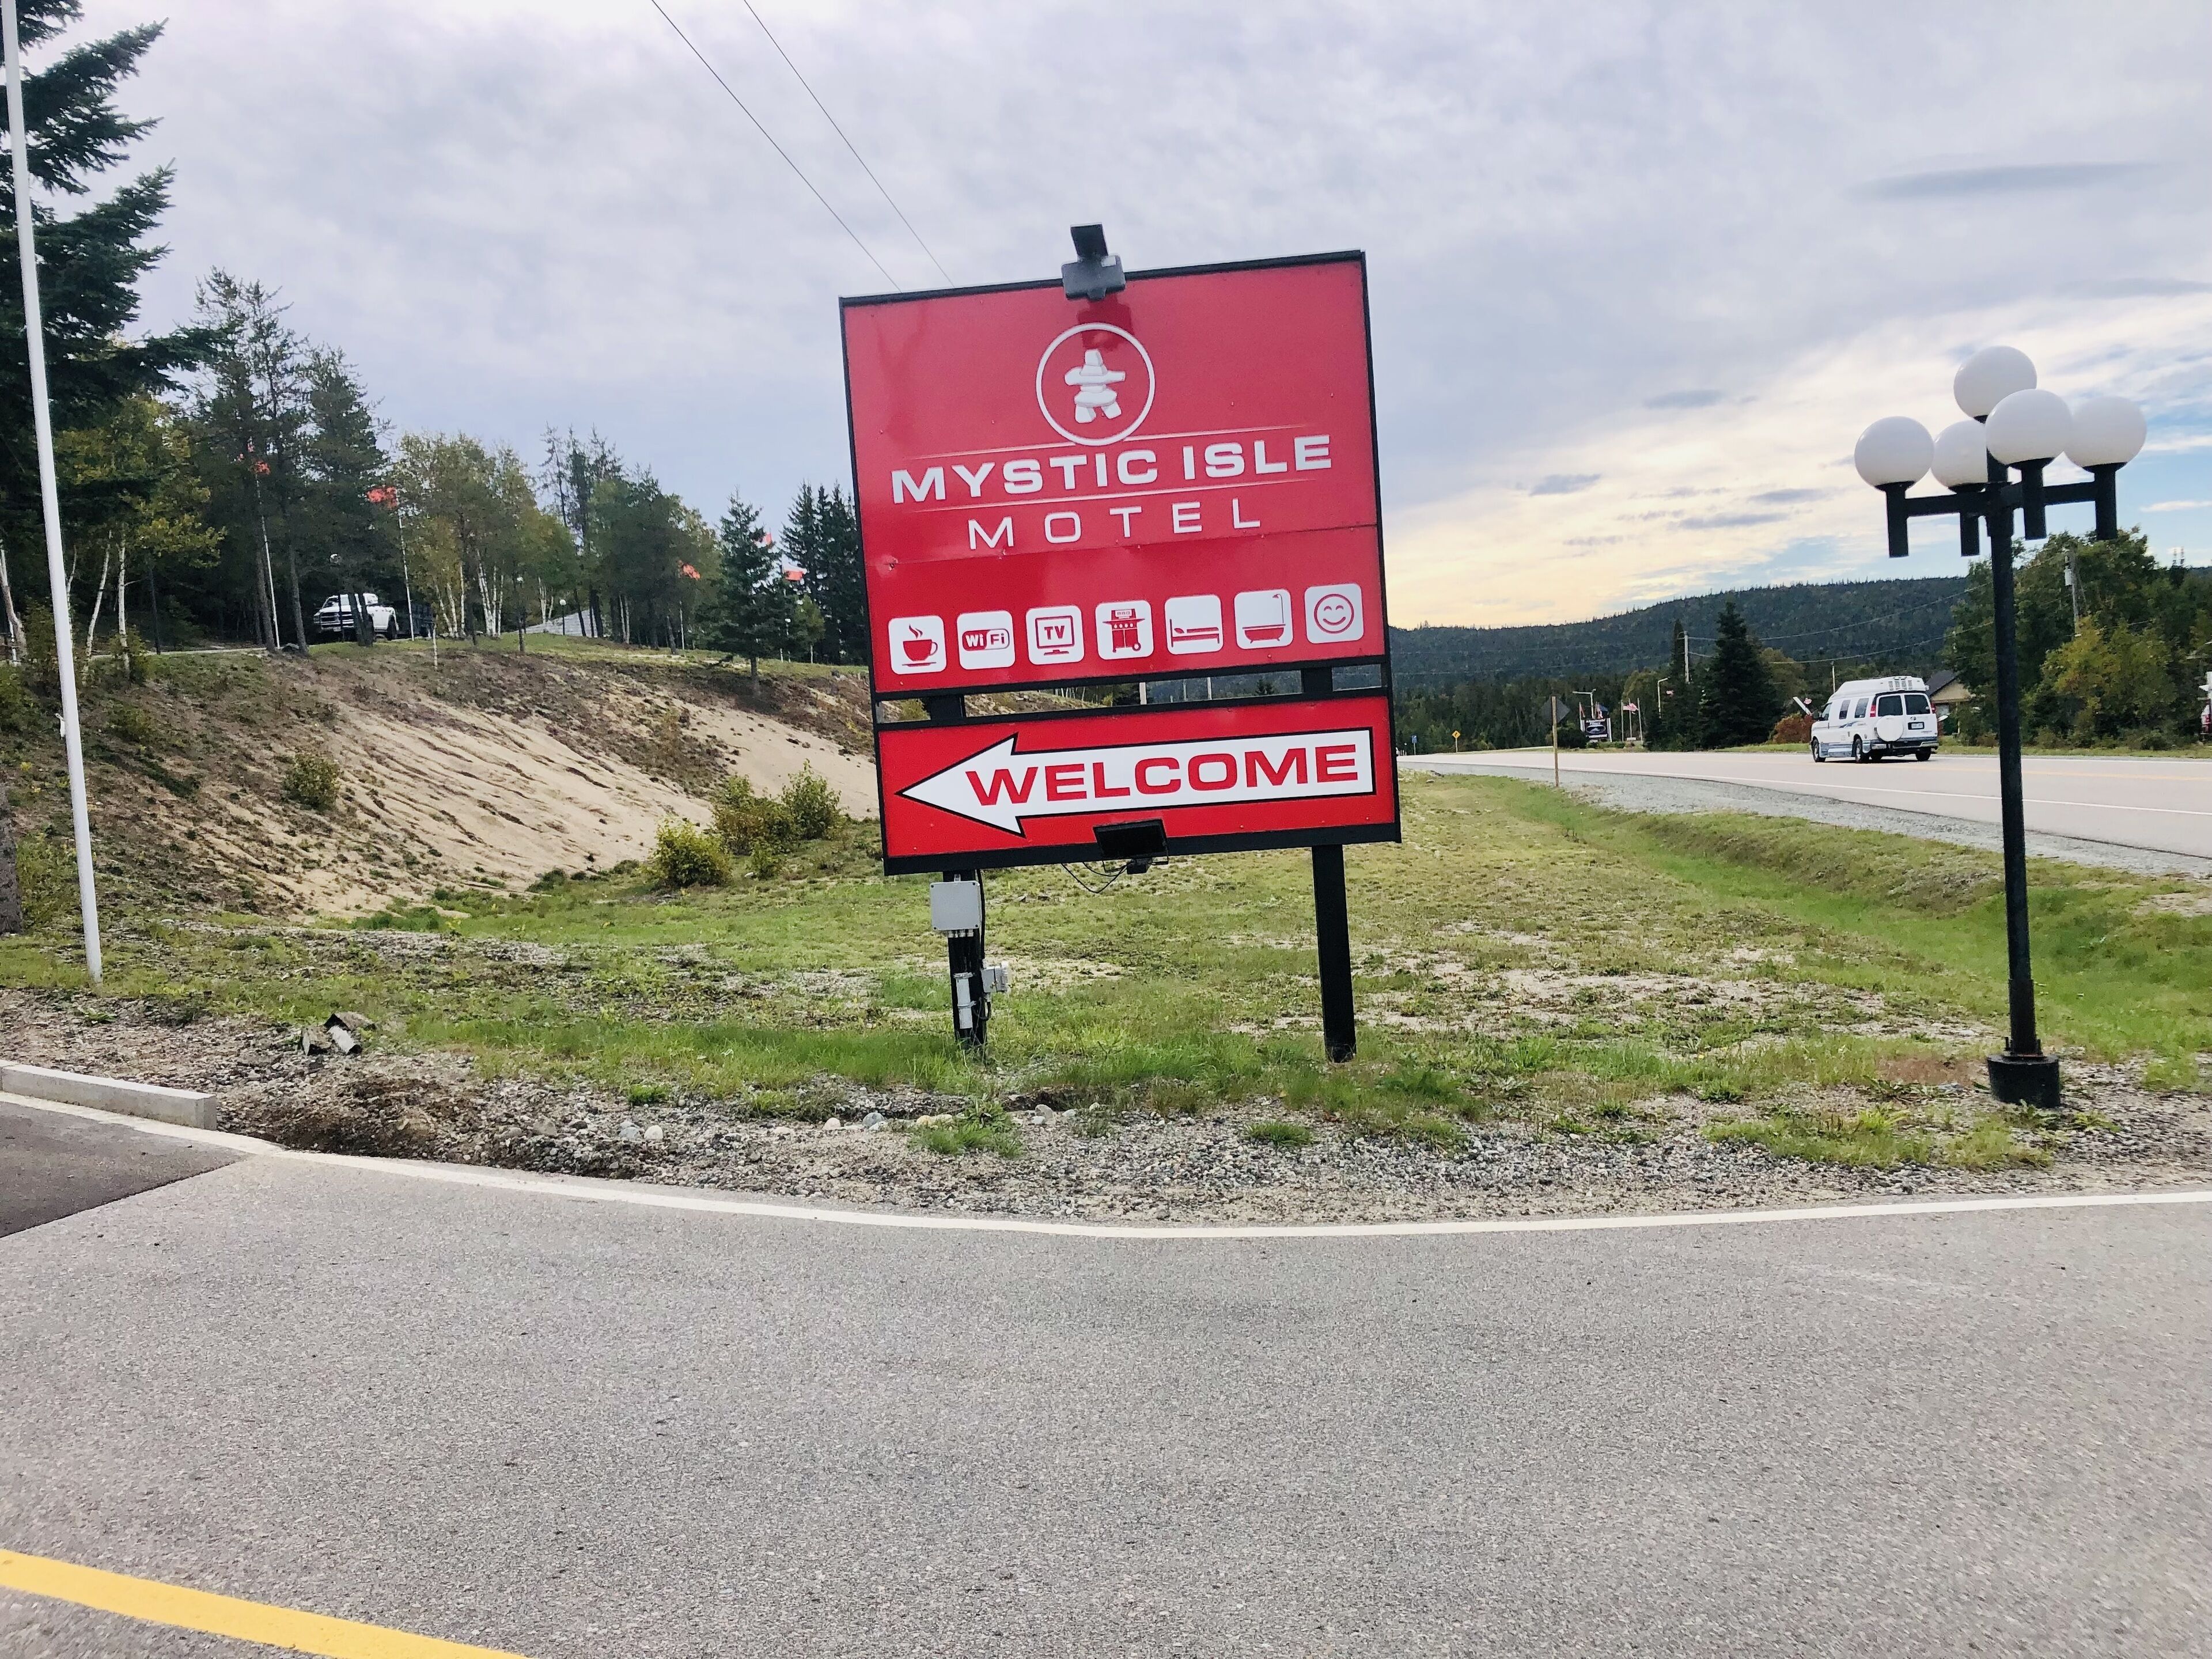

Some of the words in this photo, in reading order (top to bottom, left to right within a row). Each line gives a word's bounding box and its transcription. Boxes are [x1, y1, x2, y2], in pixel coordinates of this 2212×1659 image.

[892, 450, 1158, 503] MYSTIC
[1183, 435, 1331, 479] ISLE
[968, 499, 1260, 549] MOTEL
[1044, 626, 1065, 640] TV
[965, 745, 1358, 805] WELCOME
